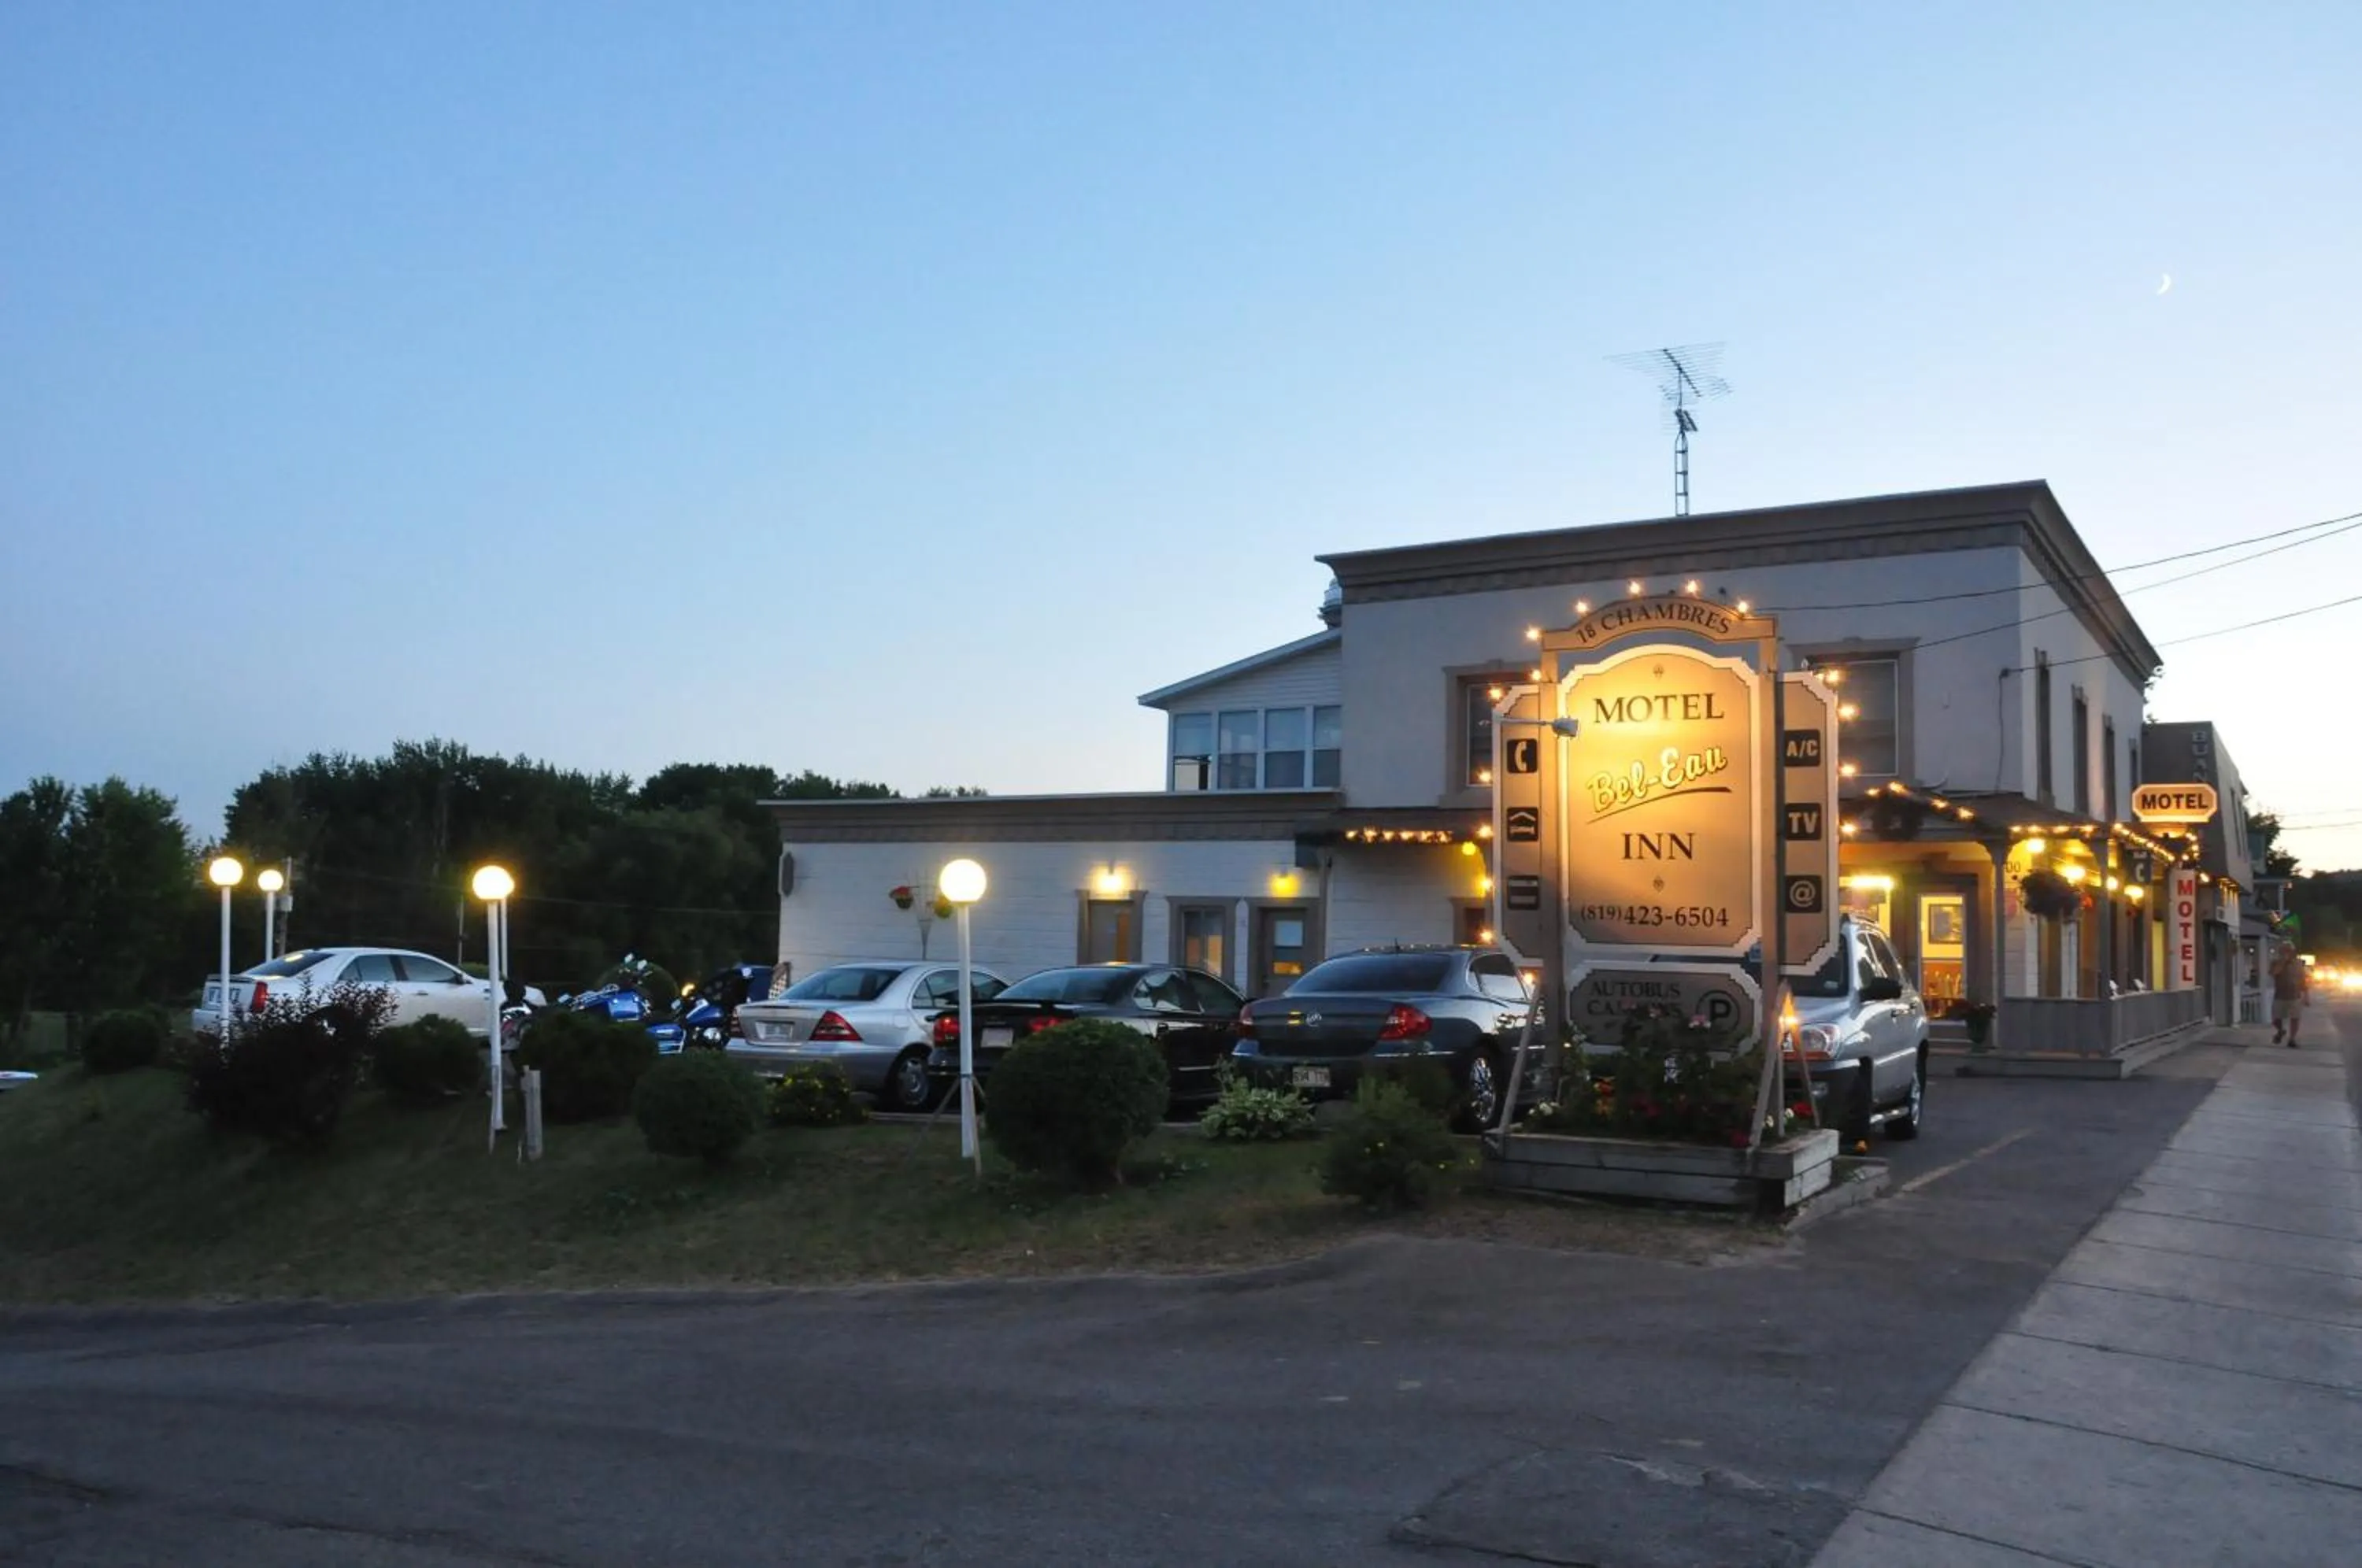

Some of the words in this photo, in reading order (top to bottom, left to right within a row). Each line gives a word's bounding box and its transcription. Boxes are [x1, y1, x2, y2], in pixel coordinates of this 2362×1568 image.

[1578, 624, 1597, 644] 18
[1601, 603, 1731, 634] CHAMBRES
[1594, 692, 1725, 723] MOTEL
[1786, 737, 1819, 758] A/C
[2192, 730, 2208, 782] BUAN
[1586, 746, 1728, 813] Bel-Eau
[2141, 793, 2208, 810] MOTEL
[1788, 810, 1819, 832] TV
[1622, 833, 1696, 860] INN
[1789, 880, 1816, 907] @
[2177, 879, 2194, 982] MOTEL
[1590, 981, 1682, 997] AUTOBUS
[1709, 999, 1731, 1022] P
